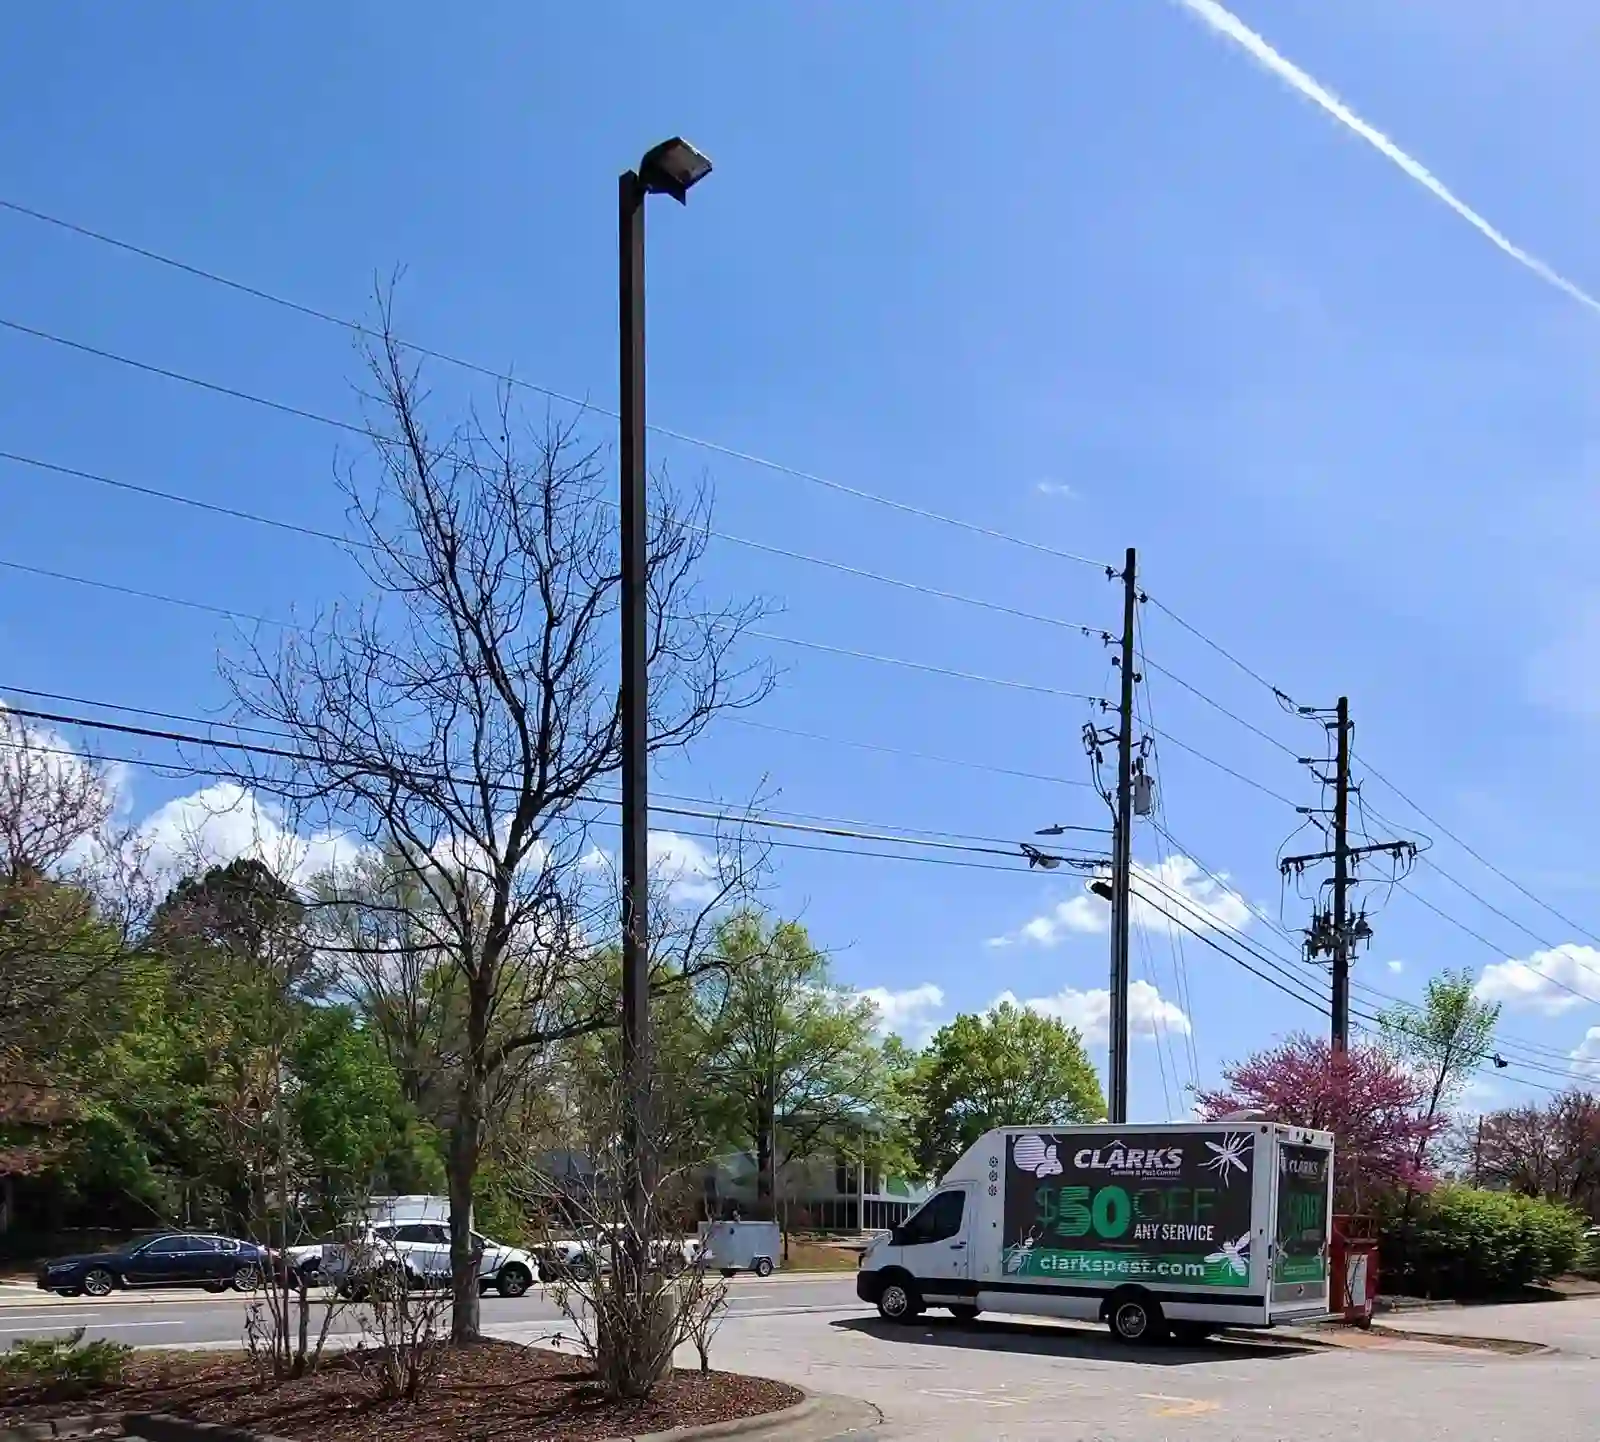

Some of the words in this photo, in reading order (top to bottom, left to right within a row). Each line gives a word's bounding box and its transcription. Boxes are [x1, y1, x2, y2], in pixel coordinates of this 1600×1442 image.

[1132, 1187, 1216, 1221] OFF
[1134, 1223, 1158, 1239] ANY
[1161, 1224, 1215, 1241] SERVICE
[1040, 1255, 1205, 1276] clarkspest.com
